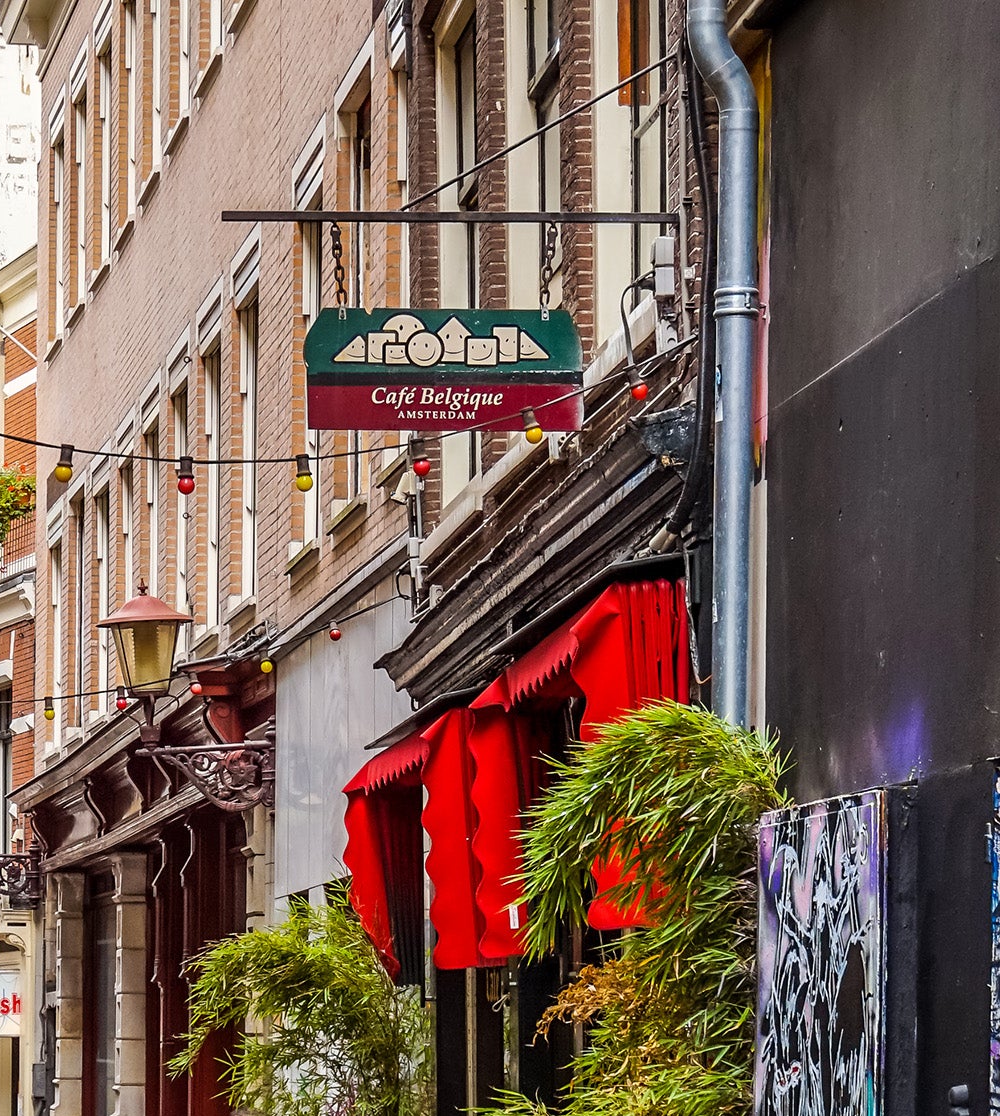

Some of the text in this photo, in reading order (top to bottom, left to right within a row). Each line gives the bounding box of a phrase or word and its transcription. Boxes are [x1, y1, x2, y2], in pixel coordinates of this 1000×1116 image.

[371, 386, 504, 411] Café Belgique
[397, 410, 477, 420] AMSTERDAM
